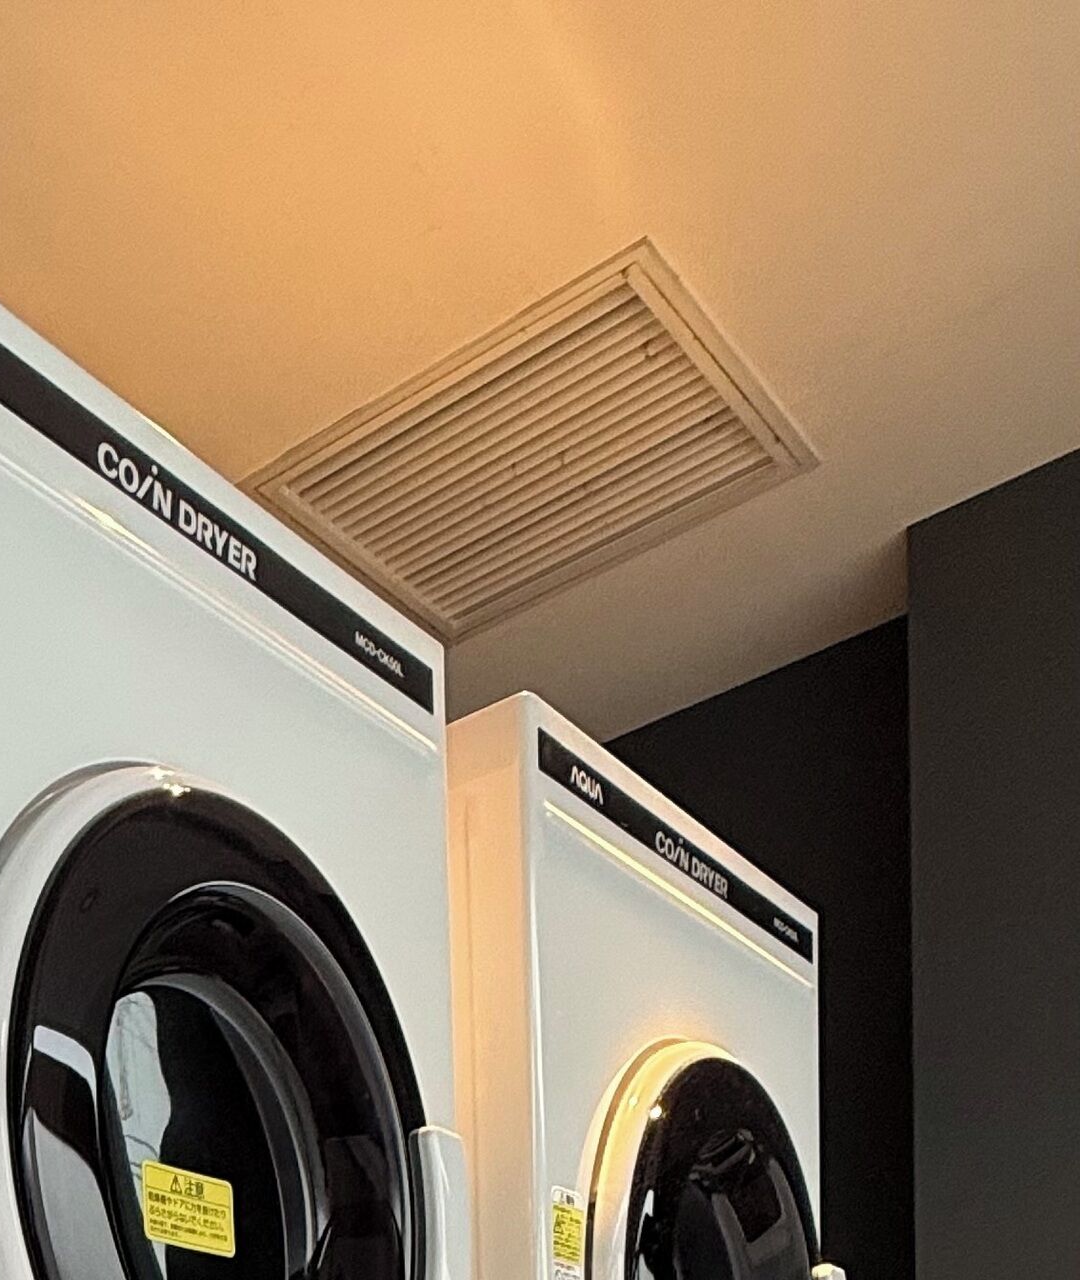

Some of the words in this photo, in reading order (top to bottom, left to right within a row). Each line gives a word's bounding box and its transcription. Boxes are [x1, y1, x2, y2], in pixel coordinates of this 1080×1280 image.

[178, 499, 257, 580] DRYER
[570, 765, 604, 806] AQUA
[691, 856, 728, 899] DRYER
